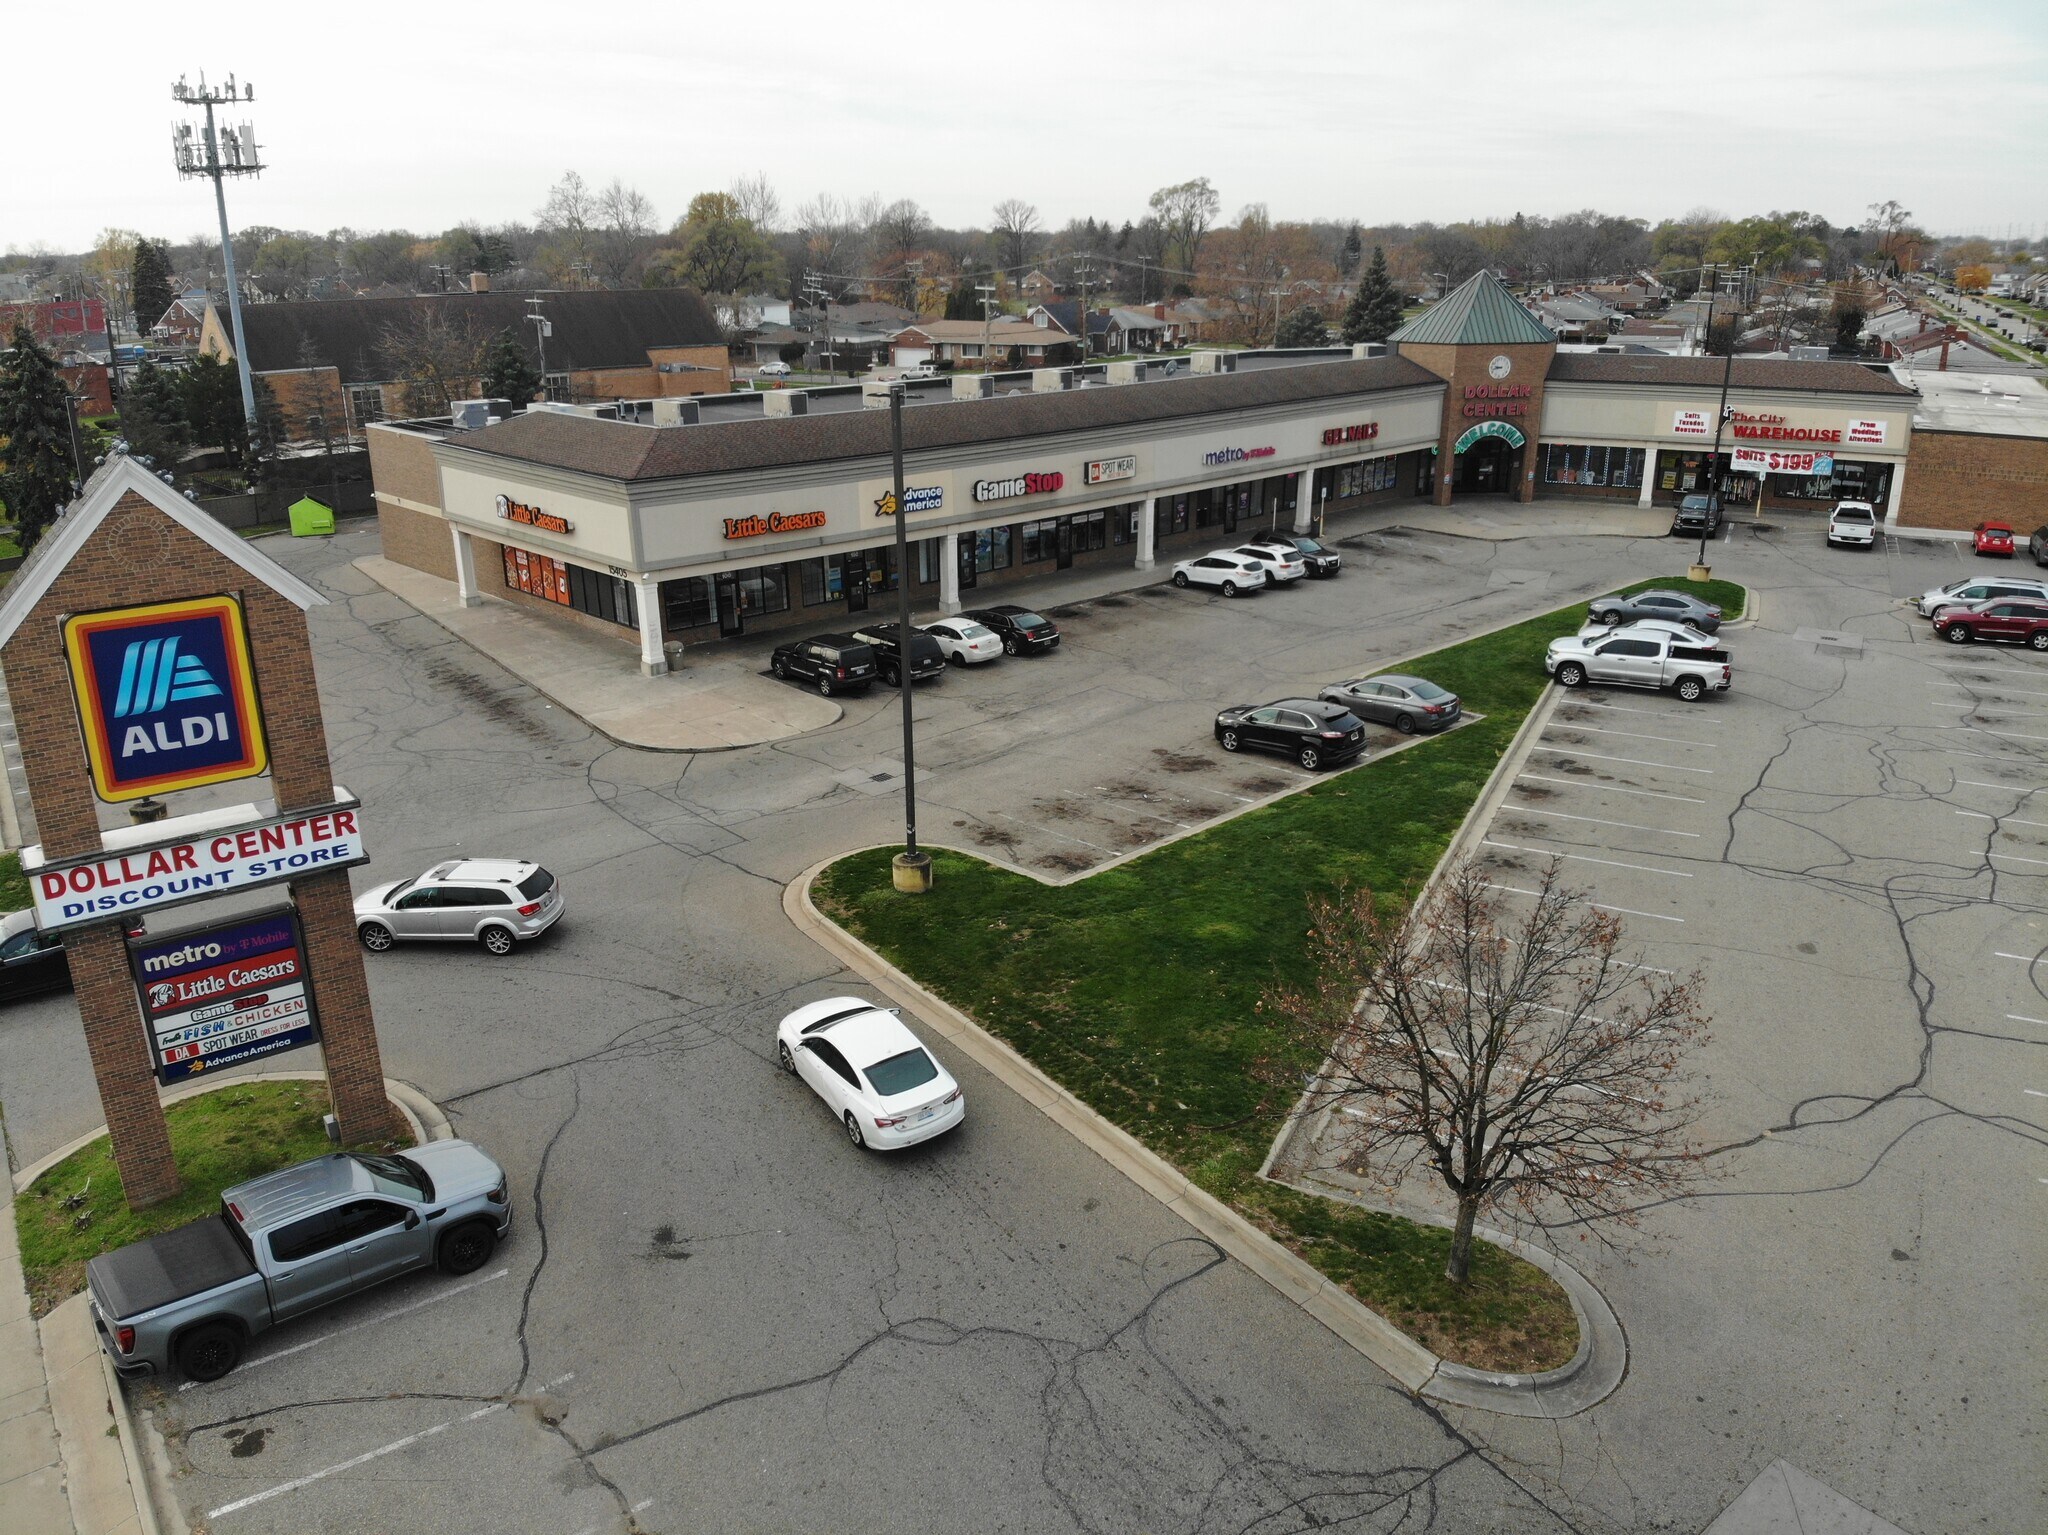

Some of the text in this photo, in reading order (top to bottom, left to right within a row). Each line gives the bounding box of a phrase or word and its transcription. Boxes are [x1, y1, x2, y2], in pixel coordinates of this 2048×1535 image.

[1464, 384, 1532, 398] DOLLAR
[1463, 402, 1529, 417] CENTER
[1732, 412, 1786, 425] The City
[1457, 422, 1525, 449] WELCOME
[1733, 425, 1842, 443] WAREHOUSE
[1101, 461, 1116, 474] SPOT
[1116, 459, 1133, 471] WEAR
[1205, 447, 1243, 465] metro
[1735, 448, 1766, 462] SUITS
[1768, 452, 1814, 471] $199
[974, 472, 1064, 502] GameStop
[507, 501, 567, 533] Little Caesars
[724, 511, 826, 539] Little Caesars
[121, 712, 230, 758] ALDI
[40, 811, 358, 900] DOLLAR CENTER
[63, 843, 349, 918] DISCOUNT STORE
[144, 943, 221, 972] metro
[223, 944, 236, 954] by
[177, 960, 295, 1001] Little Caesars
[184, 1020, 225, 1040] FISH
[234, 999, 304, 1025] CHICKEN
[191, 994, 269, 1021] GameStop
[175, 1018, 305, 1060] DA SPOT WEAR DRESS FOR LESS
